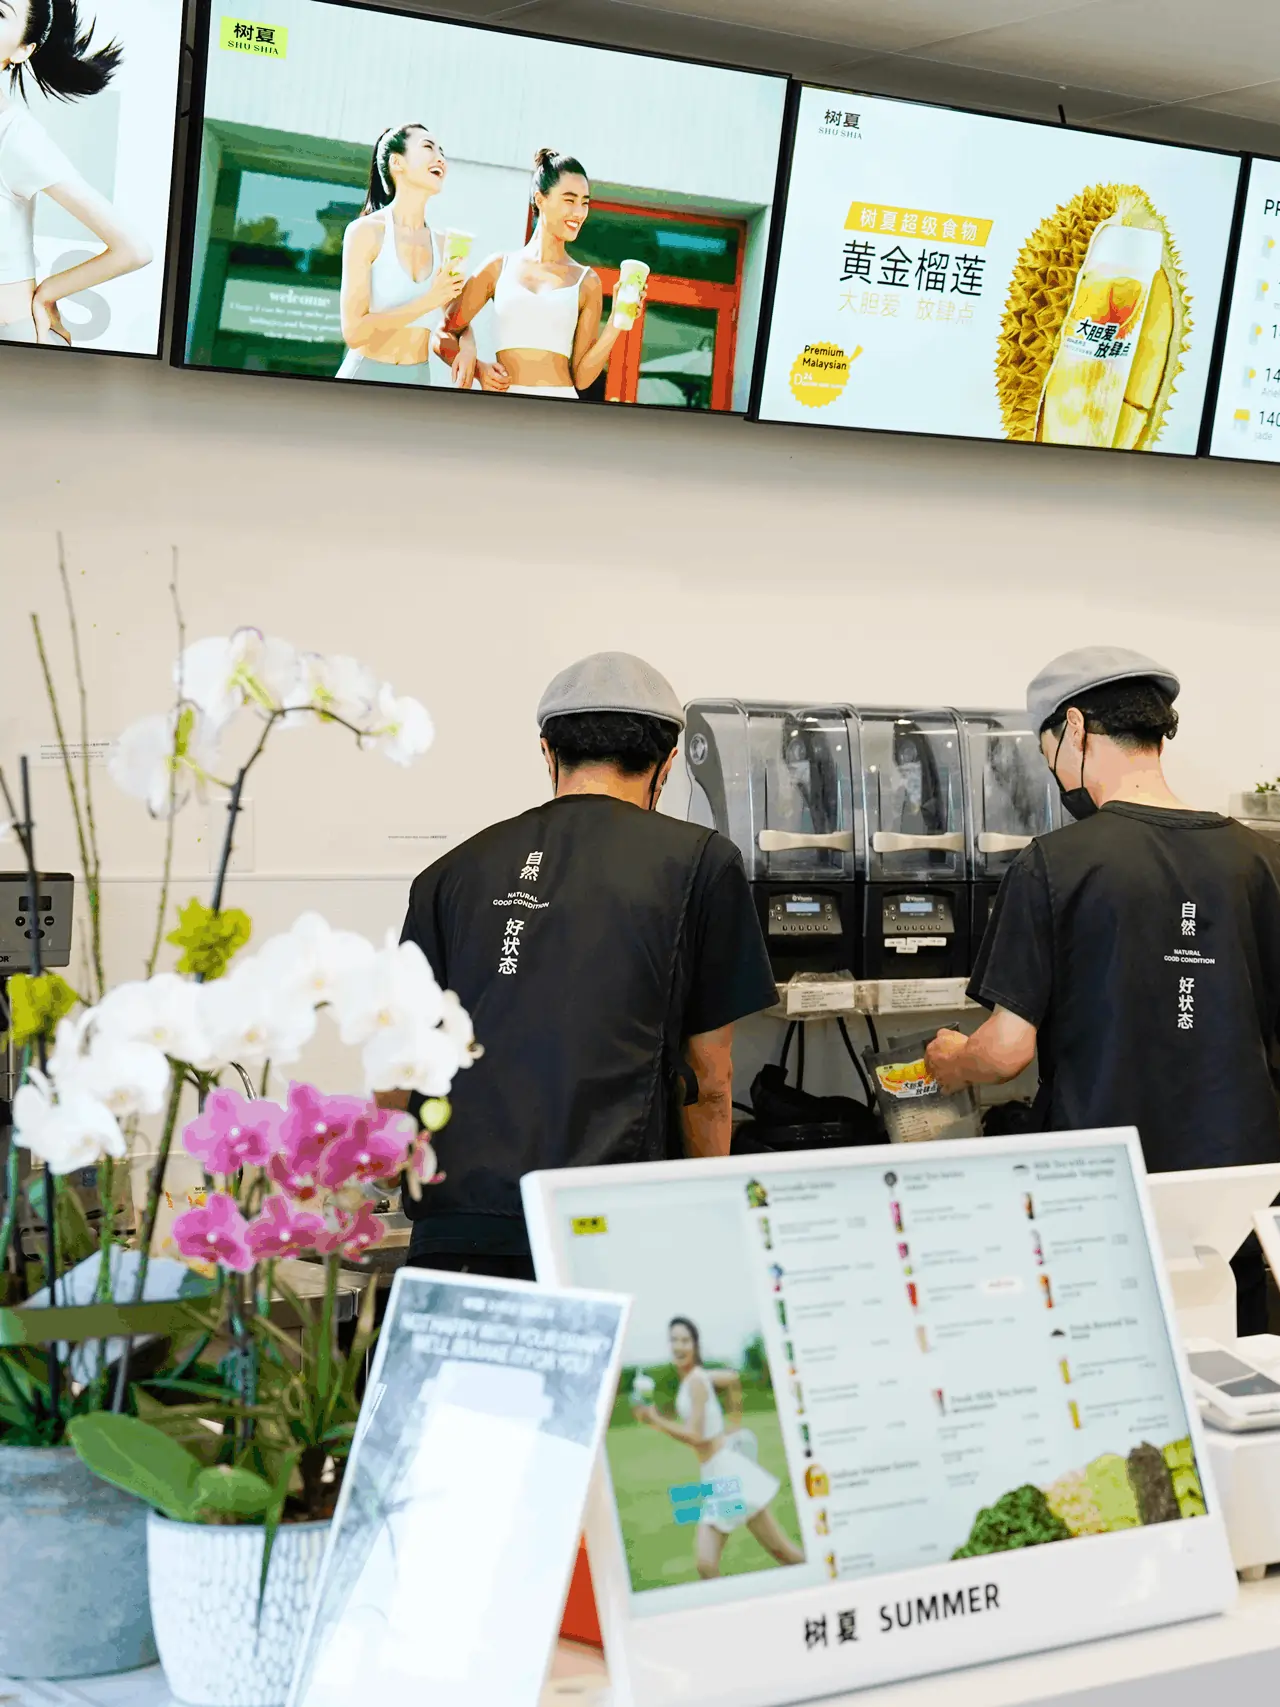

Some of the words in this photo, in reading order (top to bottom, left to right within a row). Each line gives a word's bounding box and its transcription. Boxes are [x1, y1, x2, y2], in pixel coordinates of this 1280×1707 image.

[233, 23, 276, 45] 树夏
[227, 40, 251, 50] SHU
[253, 45, 279, 55] SHIA
[824, 109, 861, 130] 树夏
[818, 126, 839, 136] SHU
[840, 129, 863, 141] SHIA
[859, 207, 979, 242] 树夏超级食物
[839, 239, 987, 297] 黄金榴莲
[1076, 319, 1118, 342] 大胆爱
[804, 344, 844, 357] Premium
[802, 357, 847, 371] Malaysian
[520, 851, 543, 881] 自然
[508, 891, 538, 903] NATURAL
[513, 898, 549, 910] CONDITION
[1181, 901, 1196, 936] 自然
[498, 918, 525, 975] 好状态
[1174, 949, 1201, 957] NATURAL
[1177, 977, 1195, 1029] 好状态
[805, 1608, 858, 1650] 树夏
[880, 1583, 1000, 1633] SUMMER
